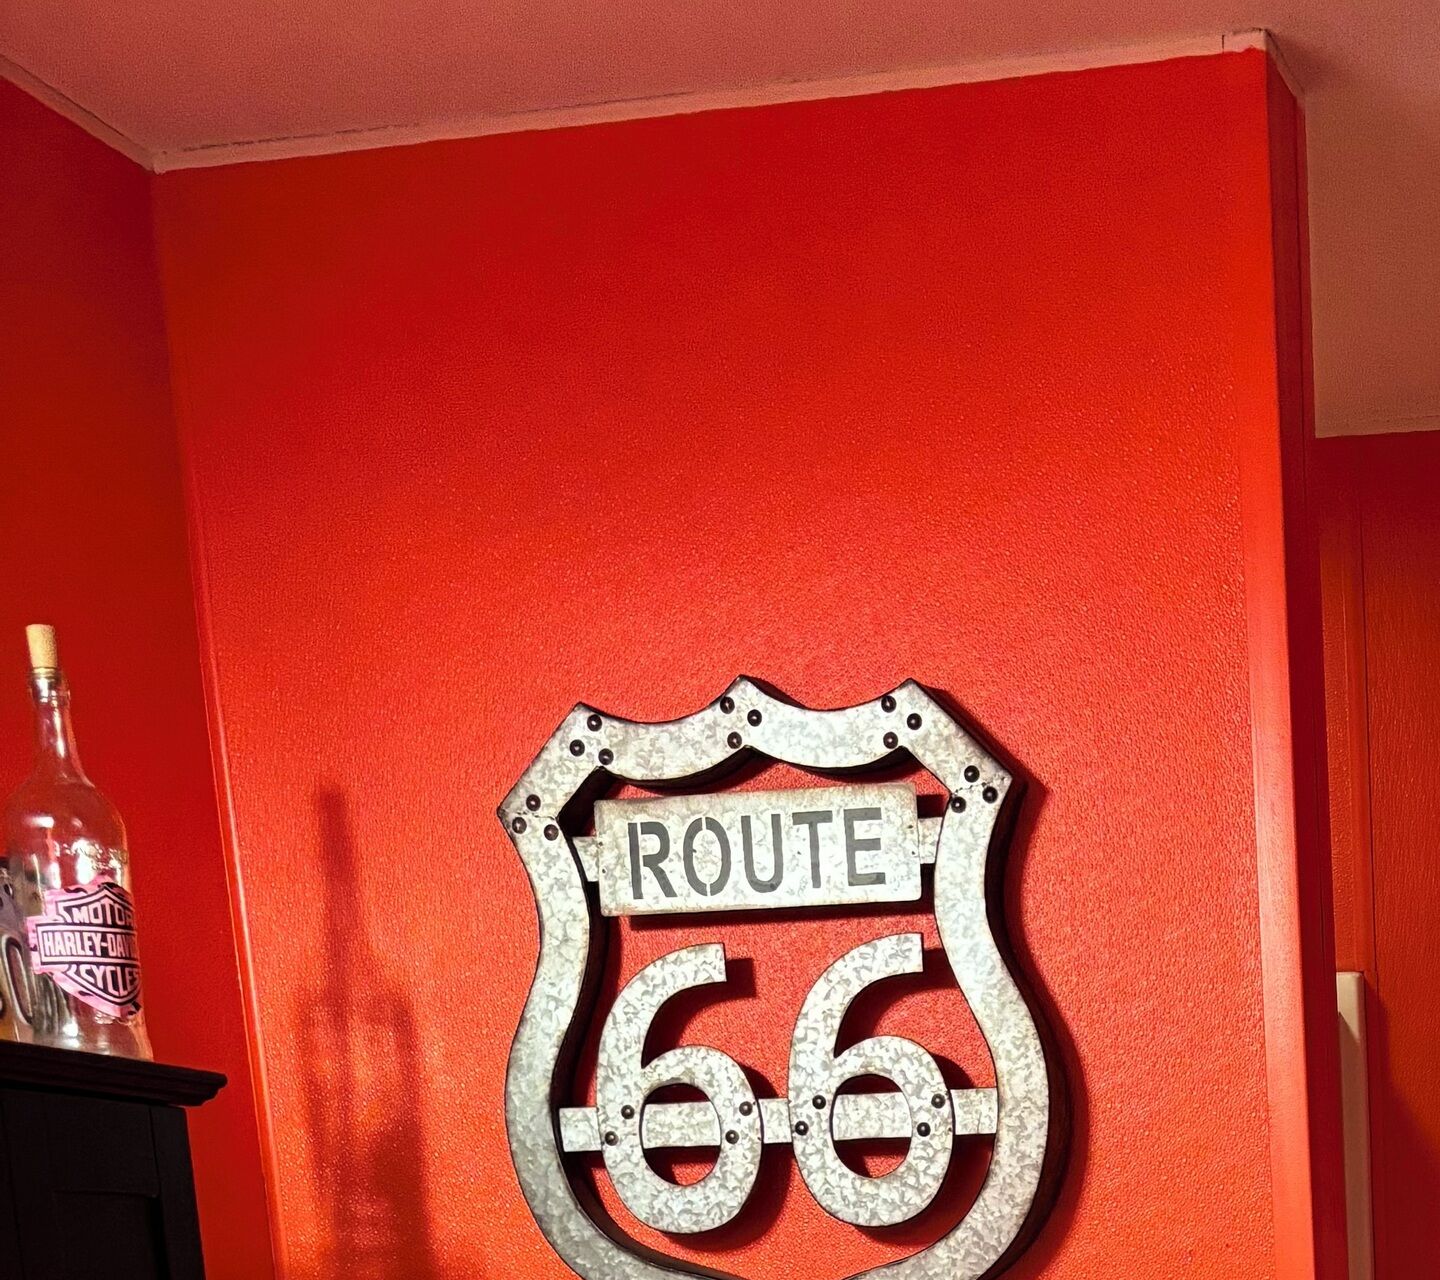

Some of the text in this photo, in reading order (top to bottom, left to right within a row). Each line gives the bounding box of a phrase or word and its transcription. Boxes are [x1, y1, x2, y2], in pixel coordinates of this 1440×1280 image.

[626, 806, 887, 899] ROUTE
[43, 931, 136, 959] HARLEY-DAVI
[597, 932, 955, 1235] 66
